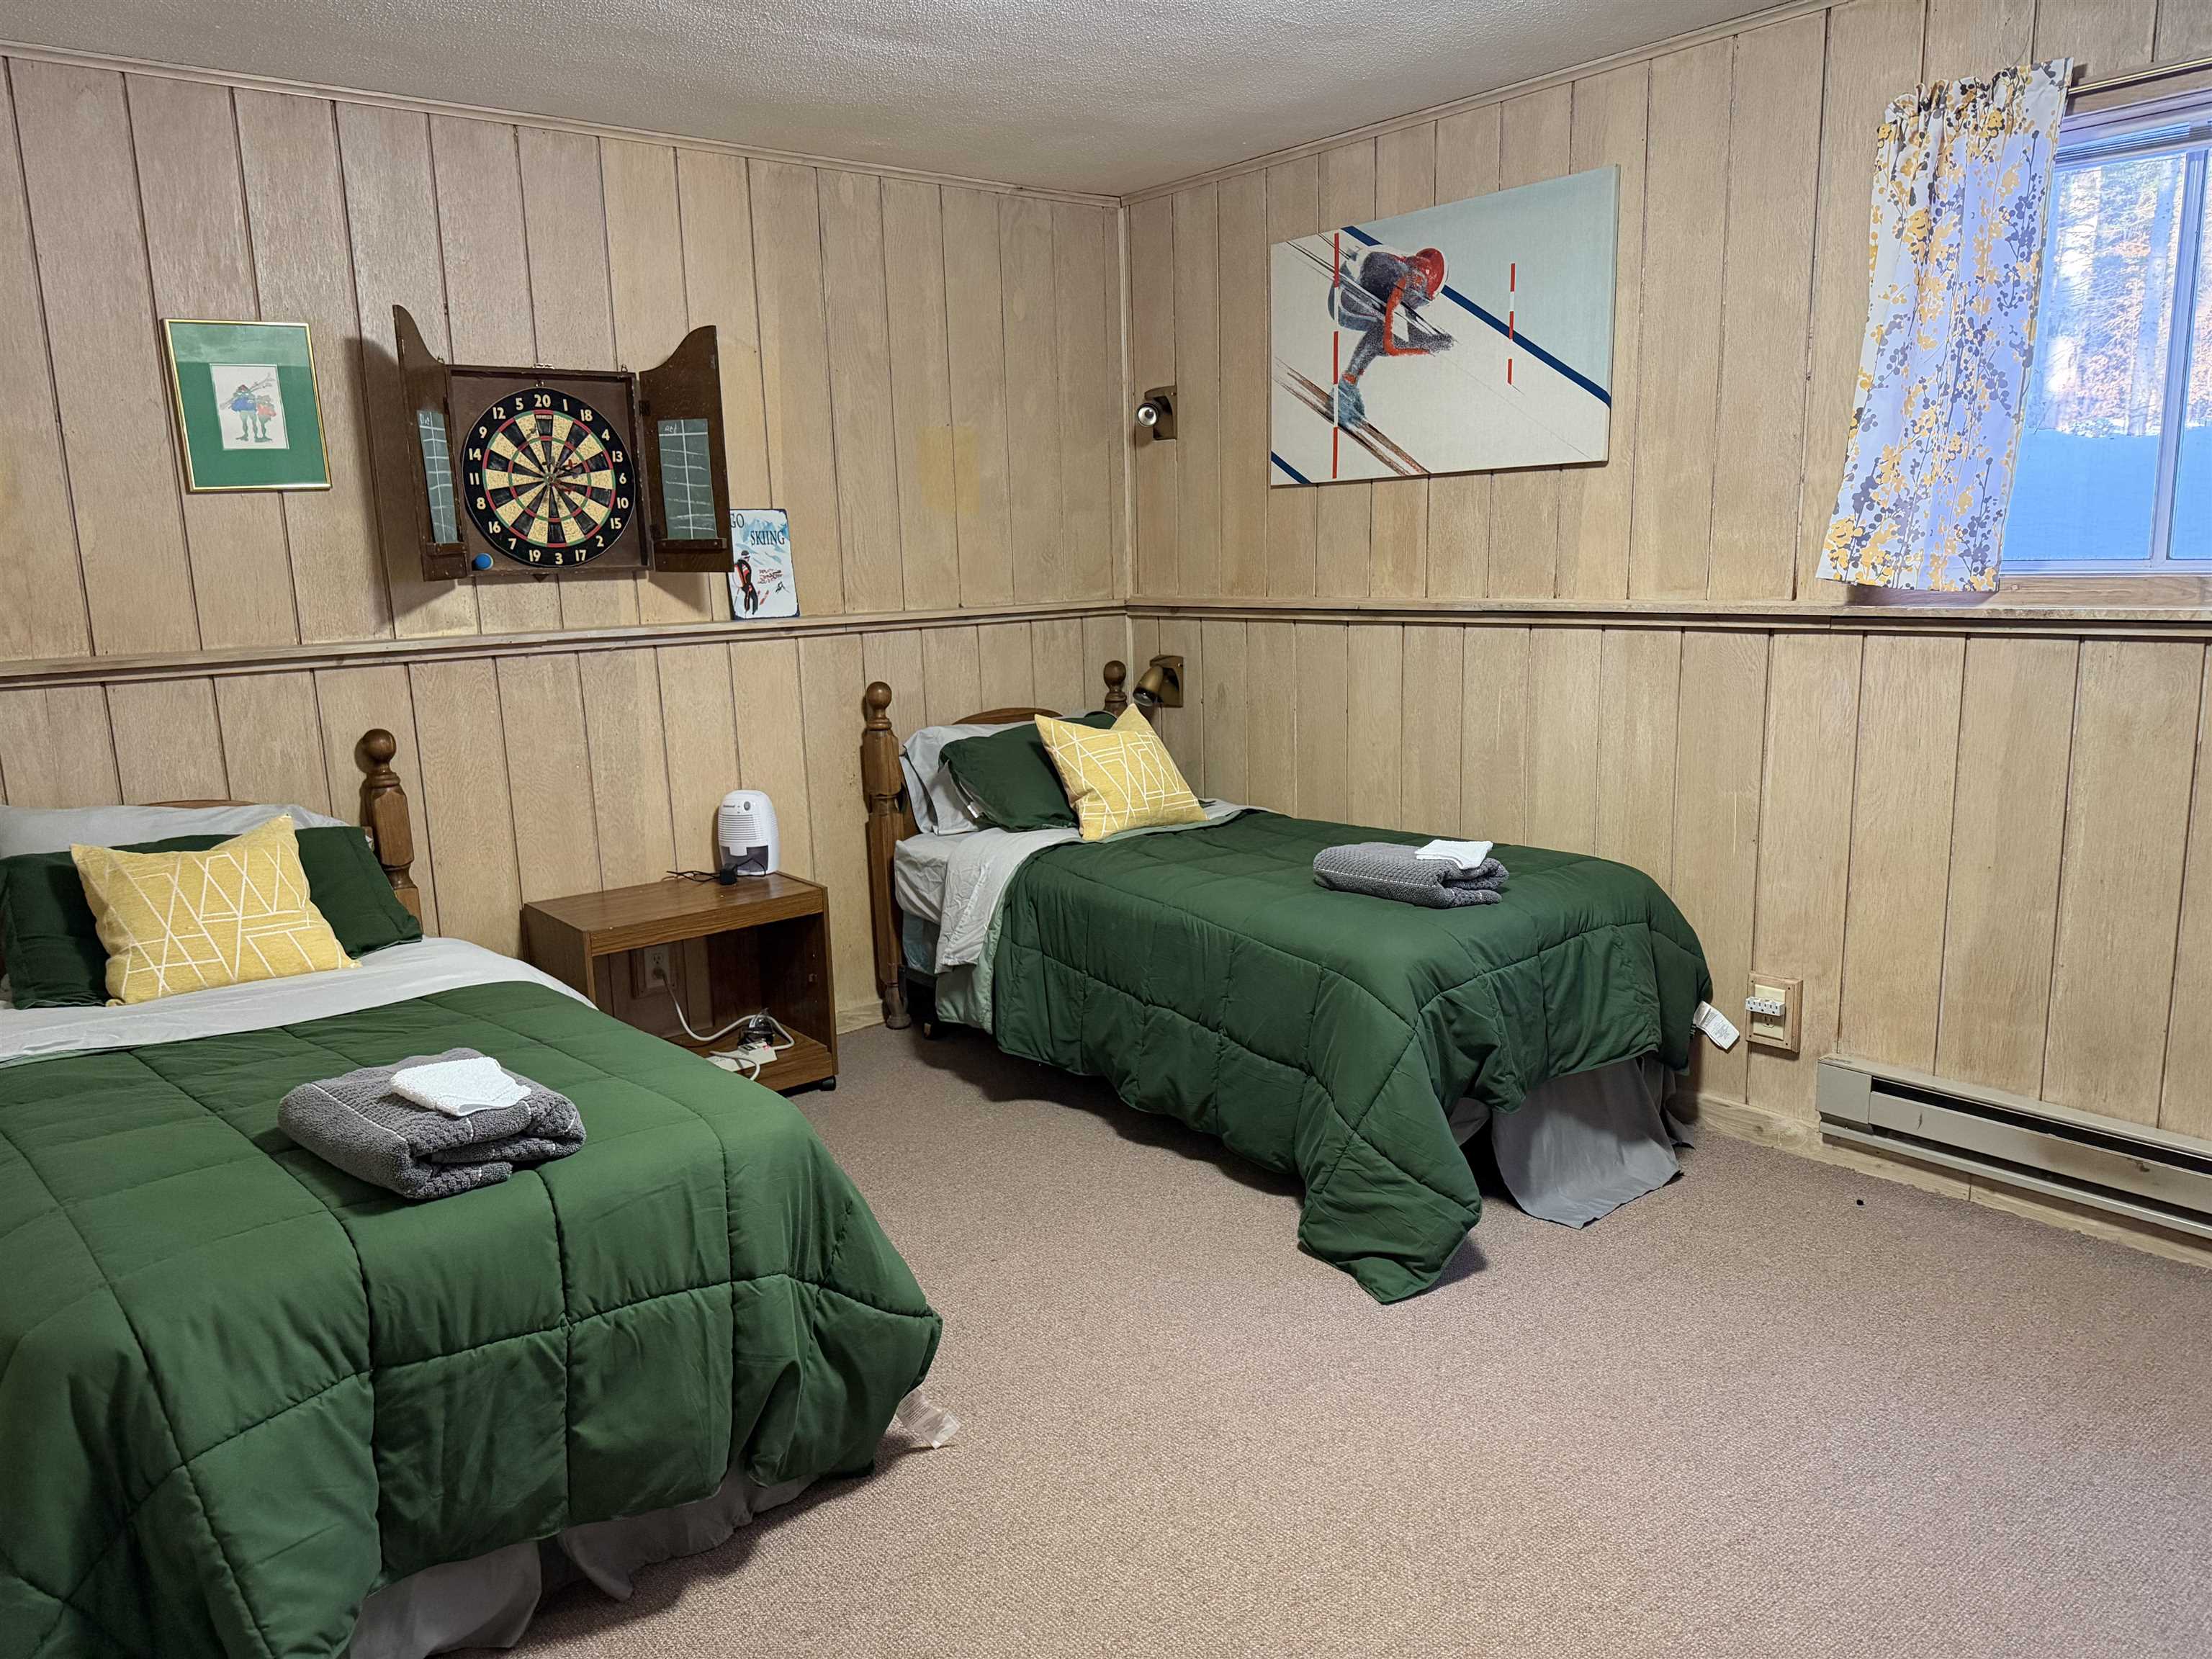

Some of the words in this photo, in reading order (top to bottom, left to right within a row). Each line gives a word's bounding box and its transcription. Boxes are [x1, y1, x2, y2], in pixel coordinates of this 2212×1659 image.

[516, 397, 523, 410] 5
[534, 395, 551, 408] 20
[563, 399, 568, 411] 1
[493, 407, 506, 419] 12
[580, 409, 593, 422] 18
[479, 426, 487, 439] 9
[601, 428, 610, 441] 4
[469, 448, 482, 461] 14
[612, 451, 623, 462] 13
[469, 473, 480, 485] 11
[619, 472, 627, 484] 6
[477, 497, 486, 510] 8
[616, 497, 629, 509] 10
[611, 518, 621, 529] 15
[729, 513, 745, 528] GO
[488, 521, 501, 534] 16
[508, 538, 516, 549] 7
[596, 536, 604, 547] 2
[750, 530, 785, 545] SKIING
[529, 550, 541, 562] 19
[555, 552, 563, 565] 3
[575, 549, 587, 561] 17
